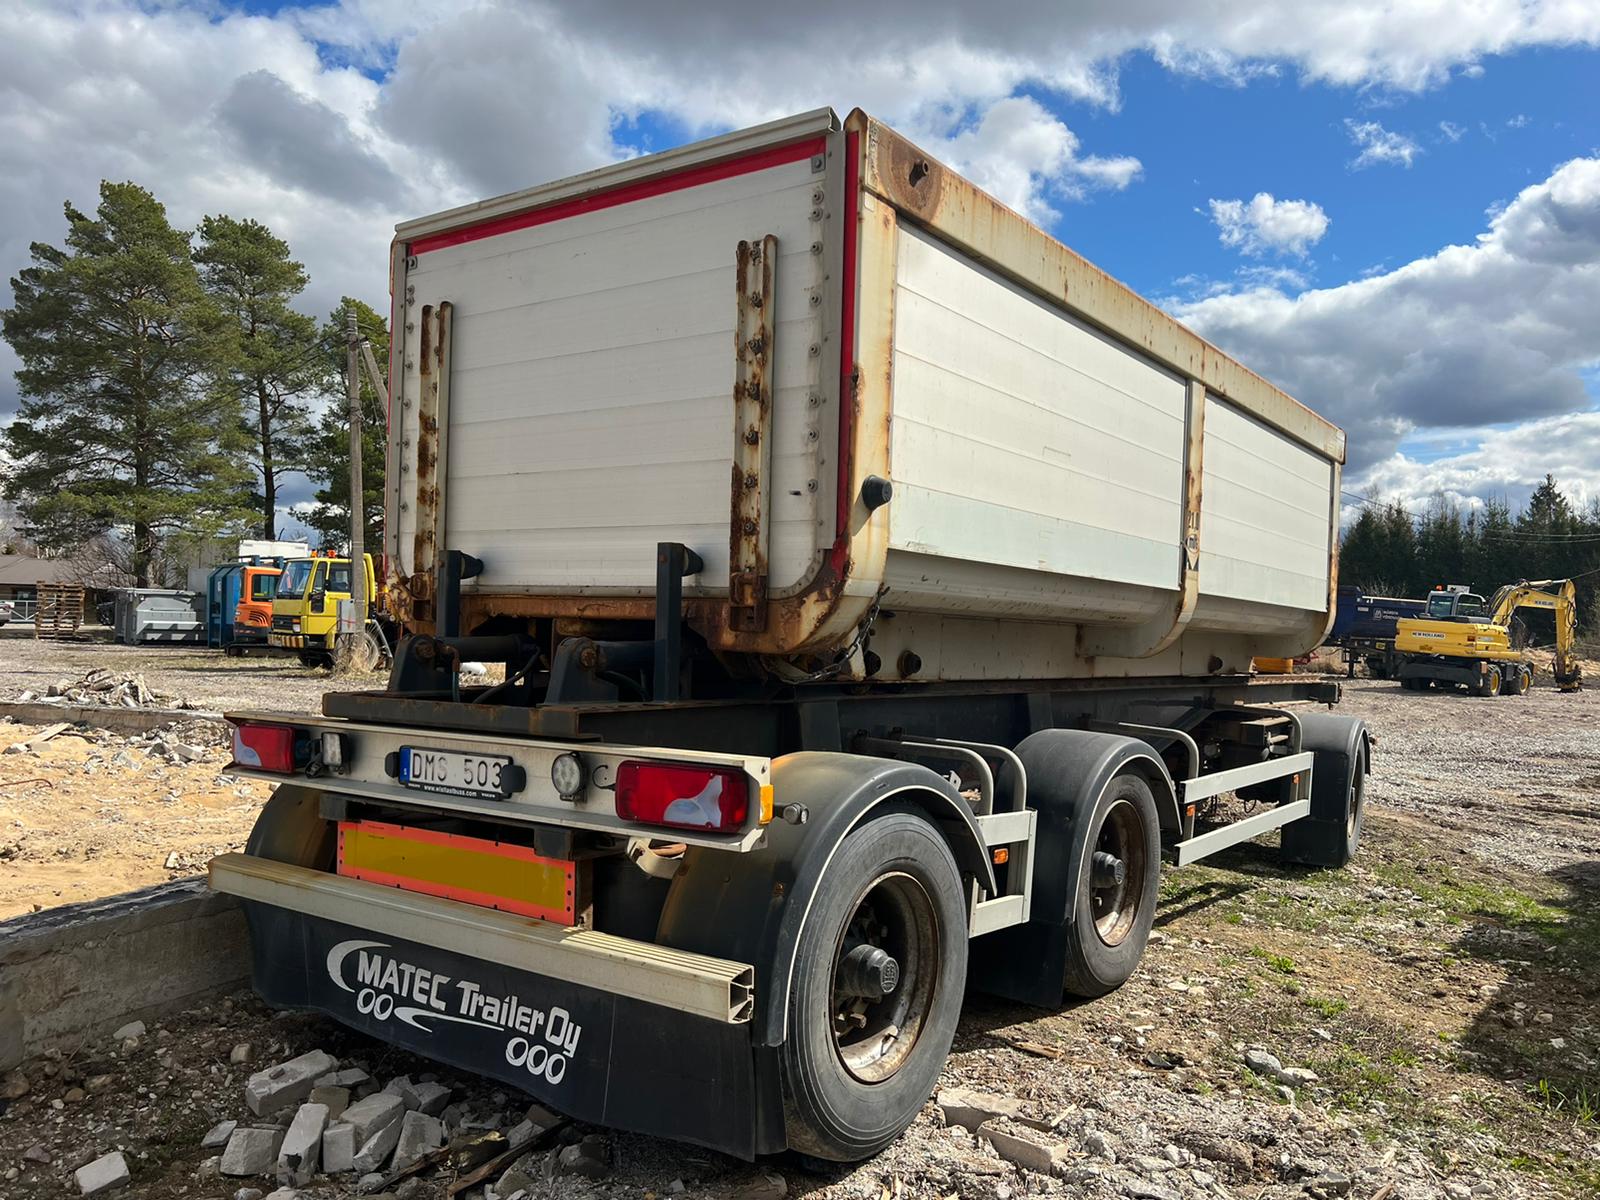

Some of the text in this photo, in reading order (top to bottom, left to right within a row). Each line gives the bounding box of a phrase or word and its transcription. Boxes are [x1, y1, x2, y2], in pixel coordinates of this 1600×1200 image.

[413, 753, 502, 789] DMS 503
[357, 950, 582, 1058] MATEC Trailer Oy
